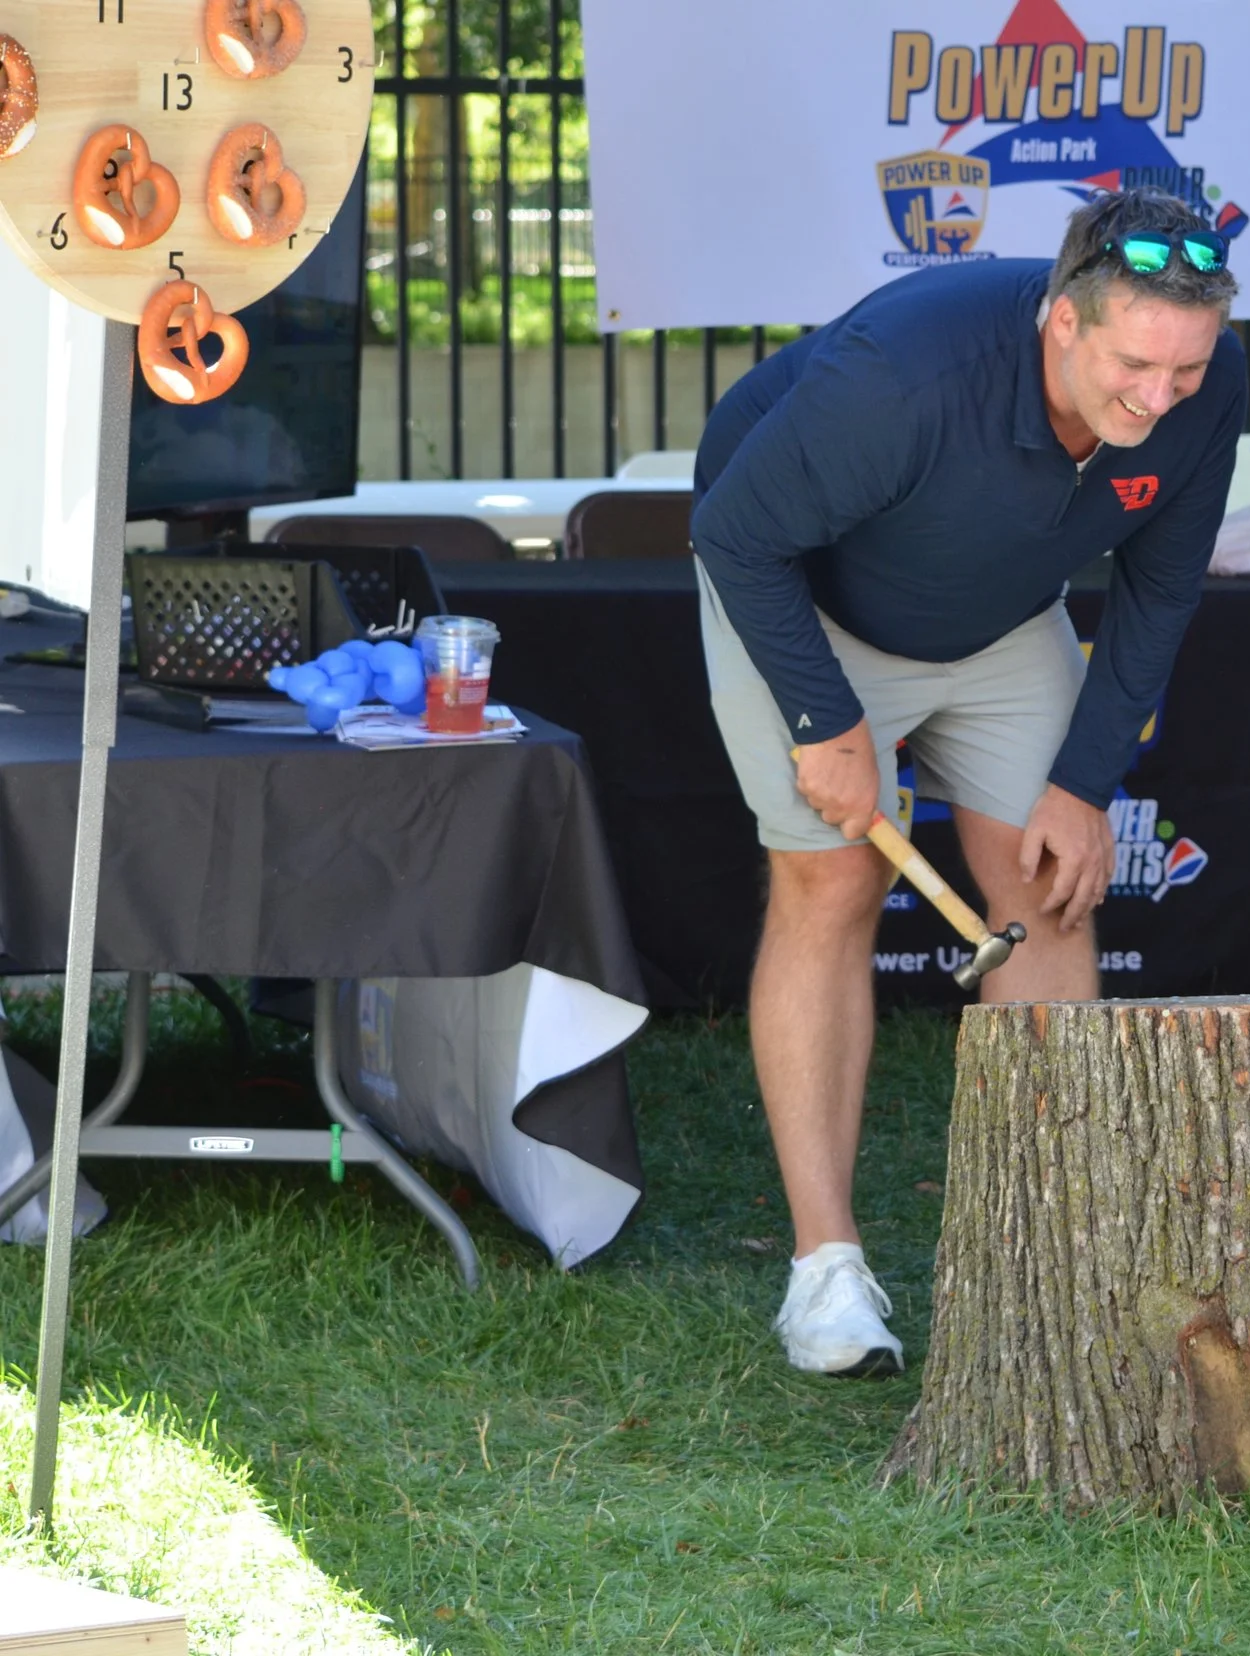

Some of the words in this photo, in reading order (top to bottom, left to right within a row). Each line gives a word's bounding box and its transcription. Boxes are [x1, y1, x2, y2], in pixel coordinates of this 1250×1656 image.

[338, 47, 353, 82] 3
[888, 26, 1205, 137] PowerUp
[162, 73, 193, 111] 13
[1010, 138, 1057, 163] Action
[1060, 137, 1097, 162] Park
[884, 161, 951, 185] POWER
[959, 164, 984, 184] UP
[50, 213, 68, 249] 6
[168, 252, 185, 280] 5
